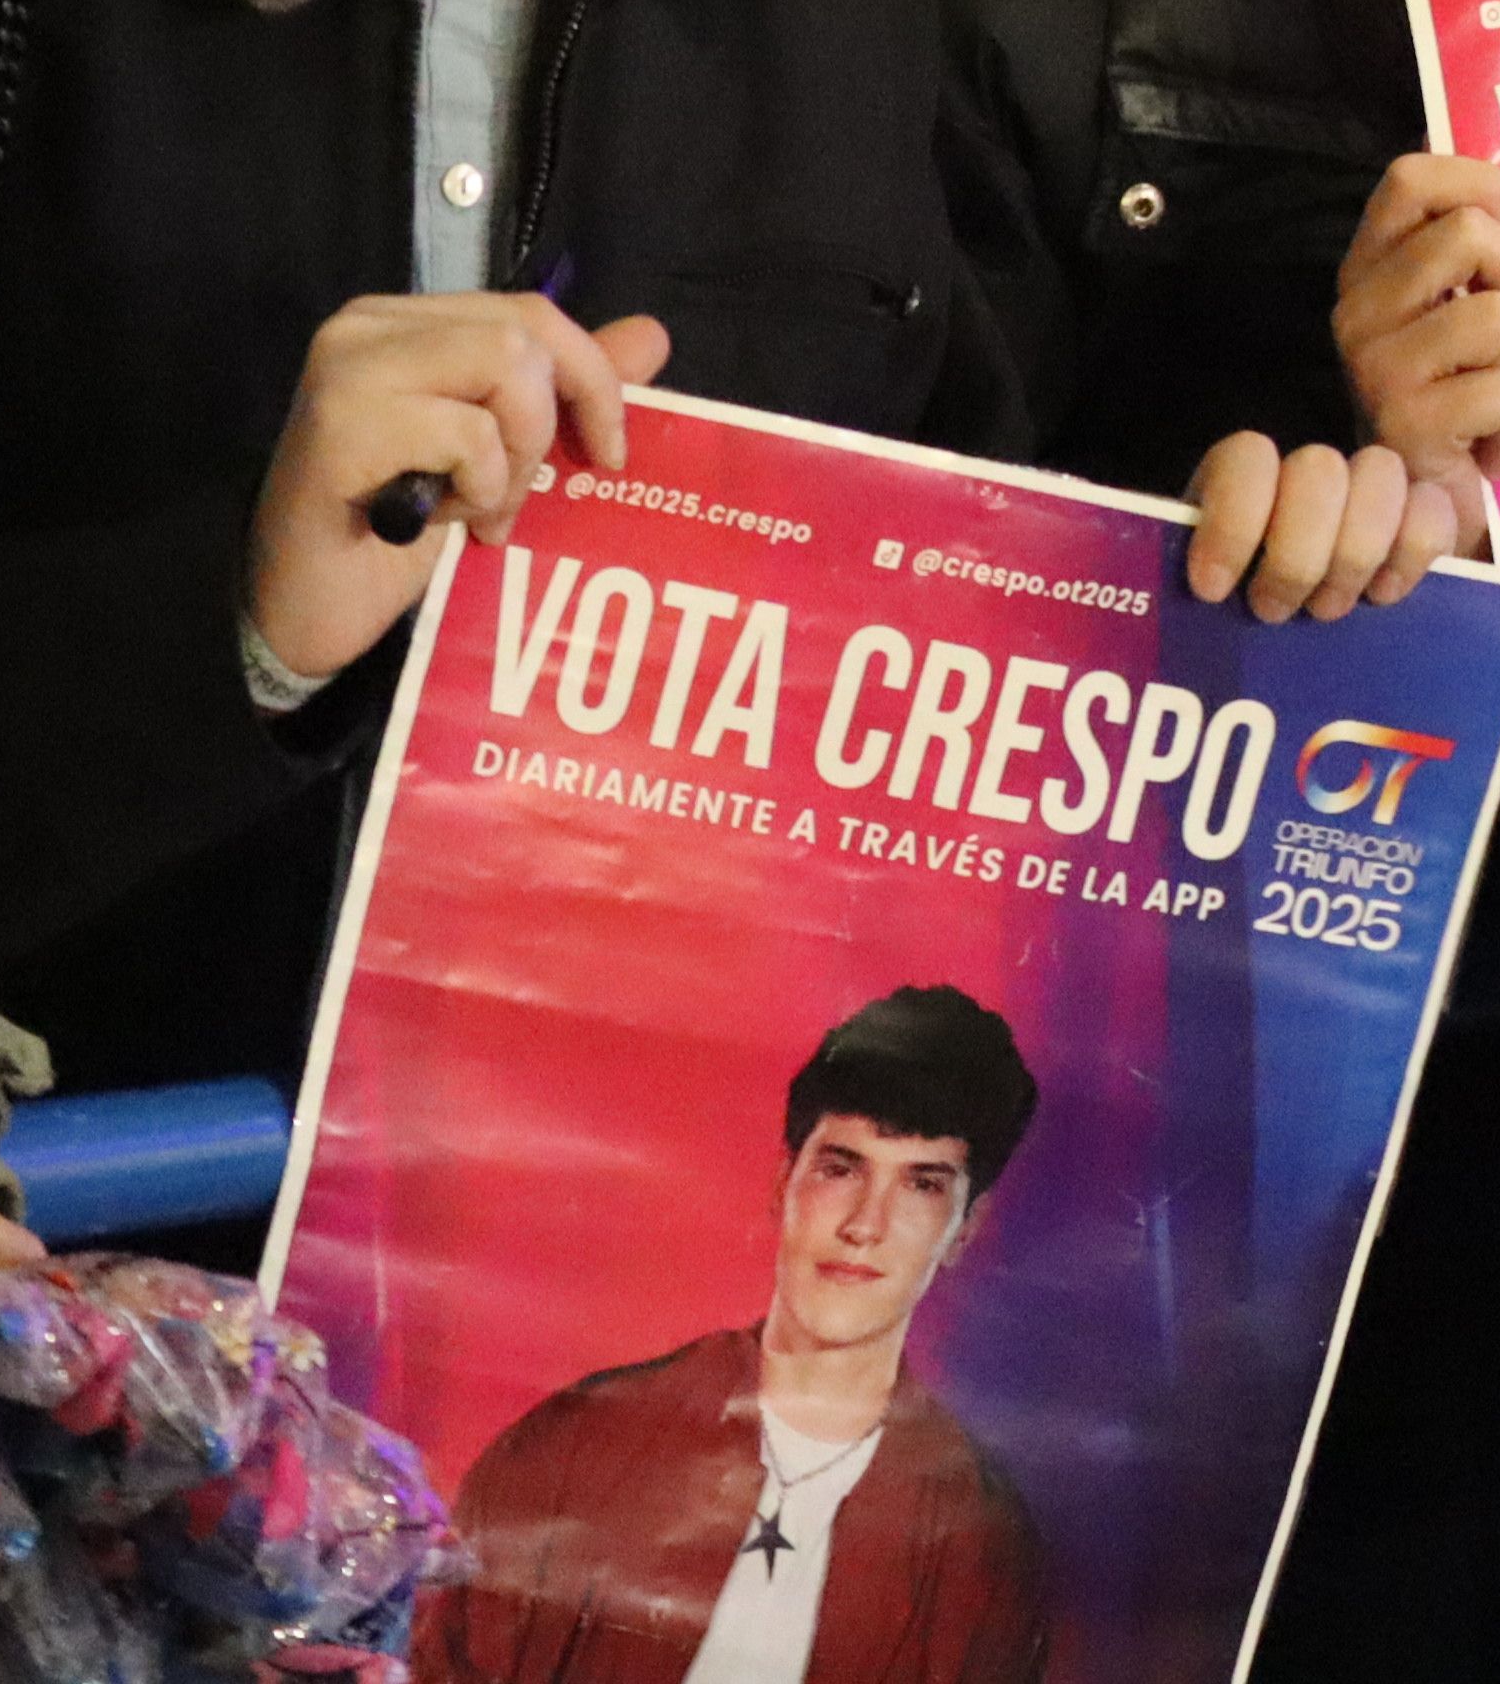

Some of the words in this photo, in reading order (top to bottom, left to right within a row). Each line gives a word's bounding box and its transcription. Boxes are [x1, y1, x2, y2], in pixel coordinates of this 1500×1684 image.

[563, 470, 813, 545] @ot2025.crespo
[911, 547, 1152, 618] @crespo.ot2025
[488, 543, 791, 770] VOTA
[813, 623, 1277, 861] CRESPO
[1294, 718, 1459, 826] OT
[471, 739, 778, 836] DIARIAMENTE
[788, 806, 818, 845] A
[837, 815, 1006, 883] TRAVÉS
[1016, 852, 1073, 896] DE
[1080, 865, 1129, 907] LA
[1142, 877, 1226, 923] APP
[1276, 819, 1425, 867] OPERACIÓN
[1271, 843, 1416, 896] TRIUNFO
[1252, 880, 1403, 952] 2025
